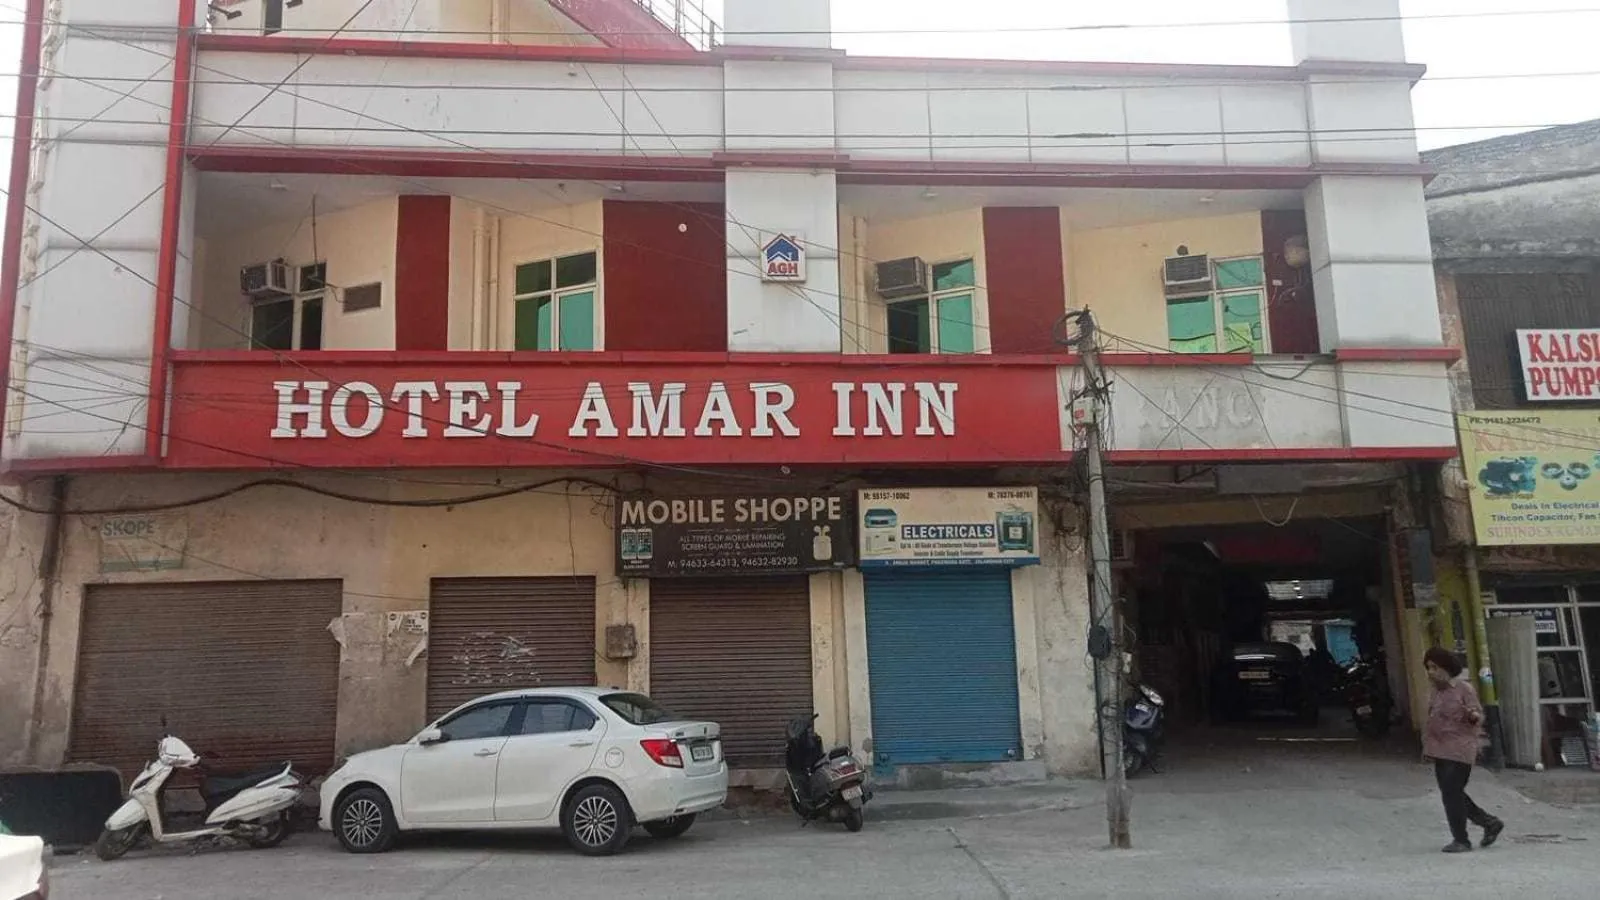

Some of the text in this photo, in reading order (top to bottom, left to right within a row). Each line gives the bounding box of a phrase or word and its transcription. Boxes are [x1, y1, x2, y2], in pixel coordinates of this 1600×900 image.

[767, 262, 798, 274] AGH
[270, 380, 959, 439] HOTEL AMAR INN
[621, 496, 841, 525] MOBILE SHOPPE
[903, 525, 993, 538] ELECTRICALS
